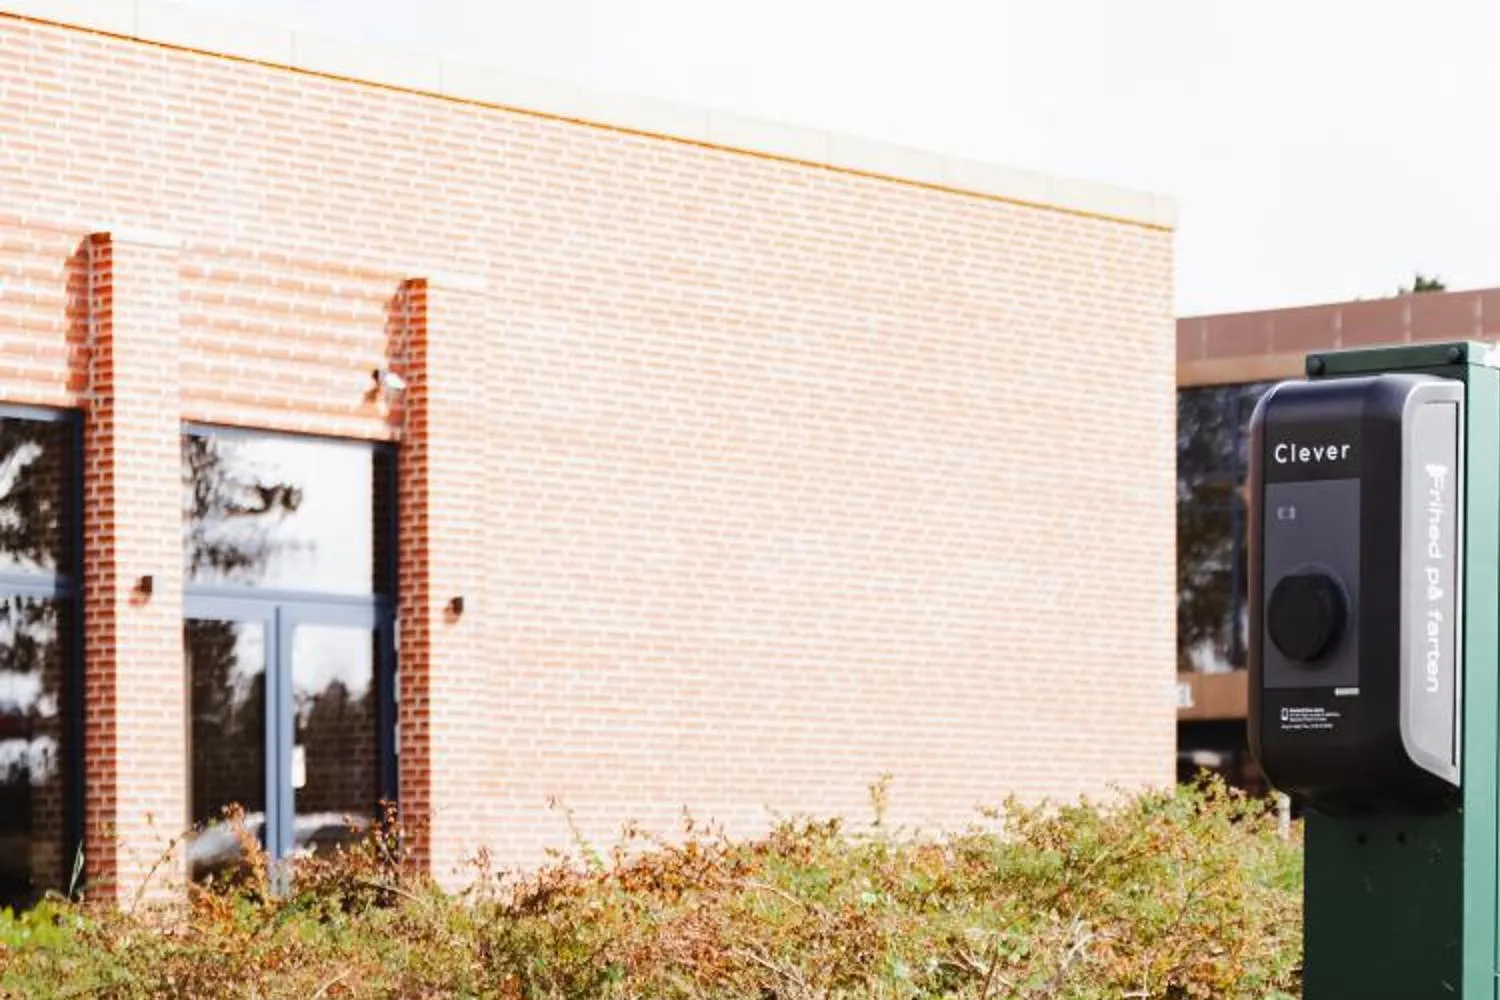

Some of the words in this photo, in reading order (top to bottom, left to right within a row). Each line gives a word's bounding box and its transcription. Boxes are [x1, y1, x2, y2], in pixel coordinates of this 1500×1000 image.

[1275, 443, 1351, 463] Clever
[1427, 468, 1445, 559] Frihed
[1425, 607, 1443, 694] farten
